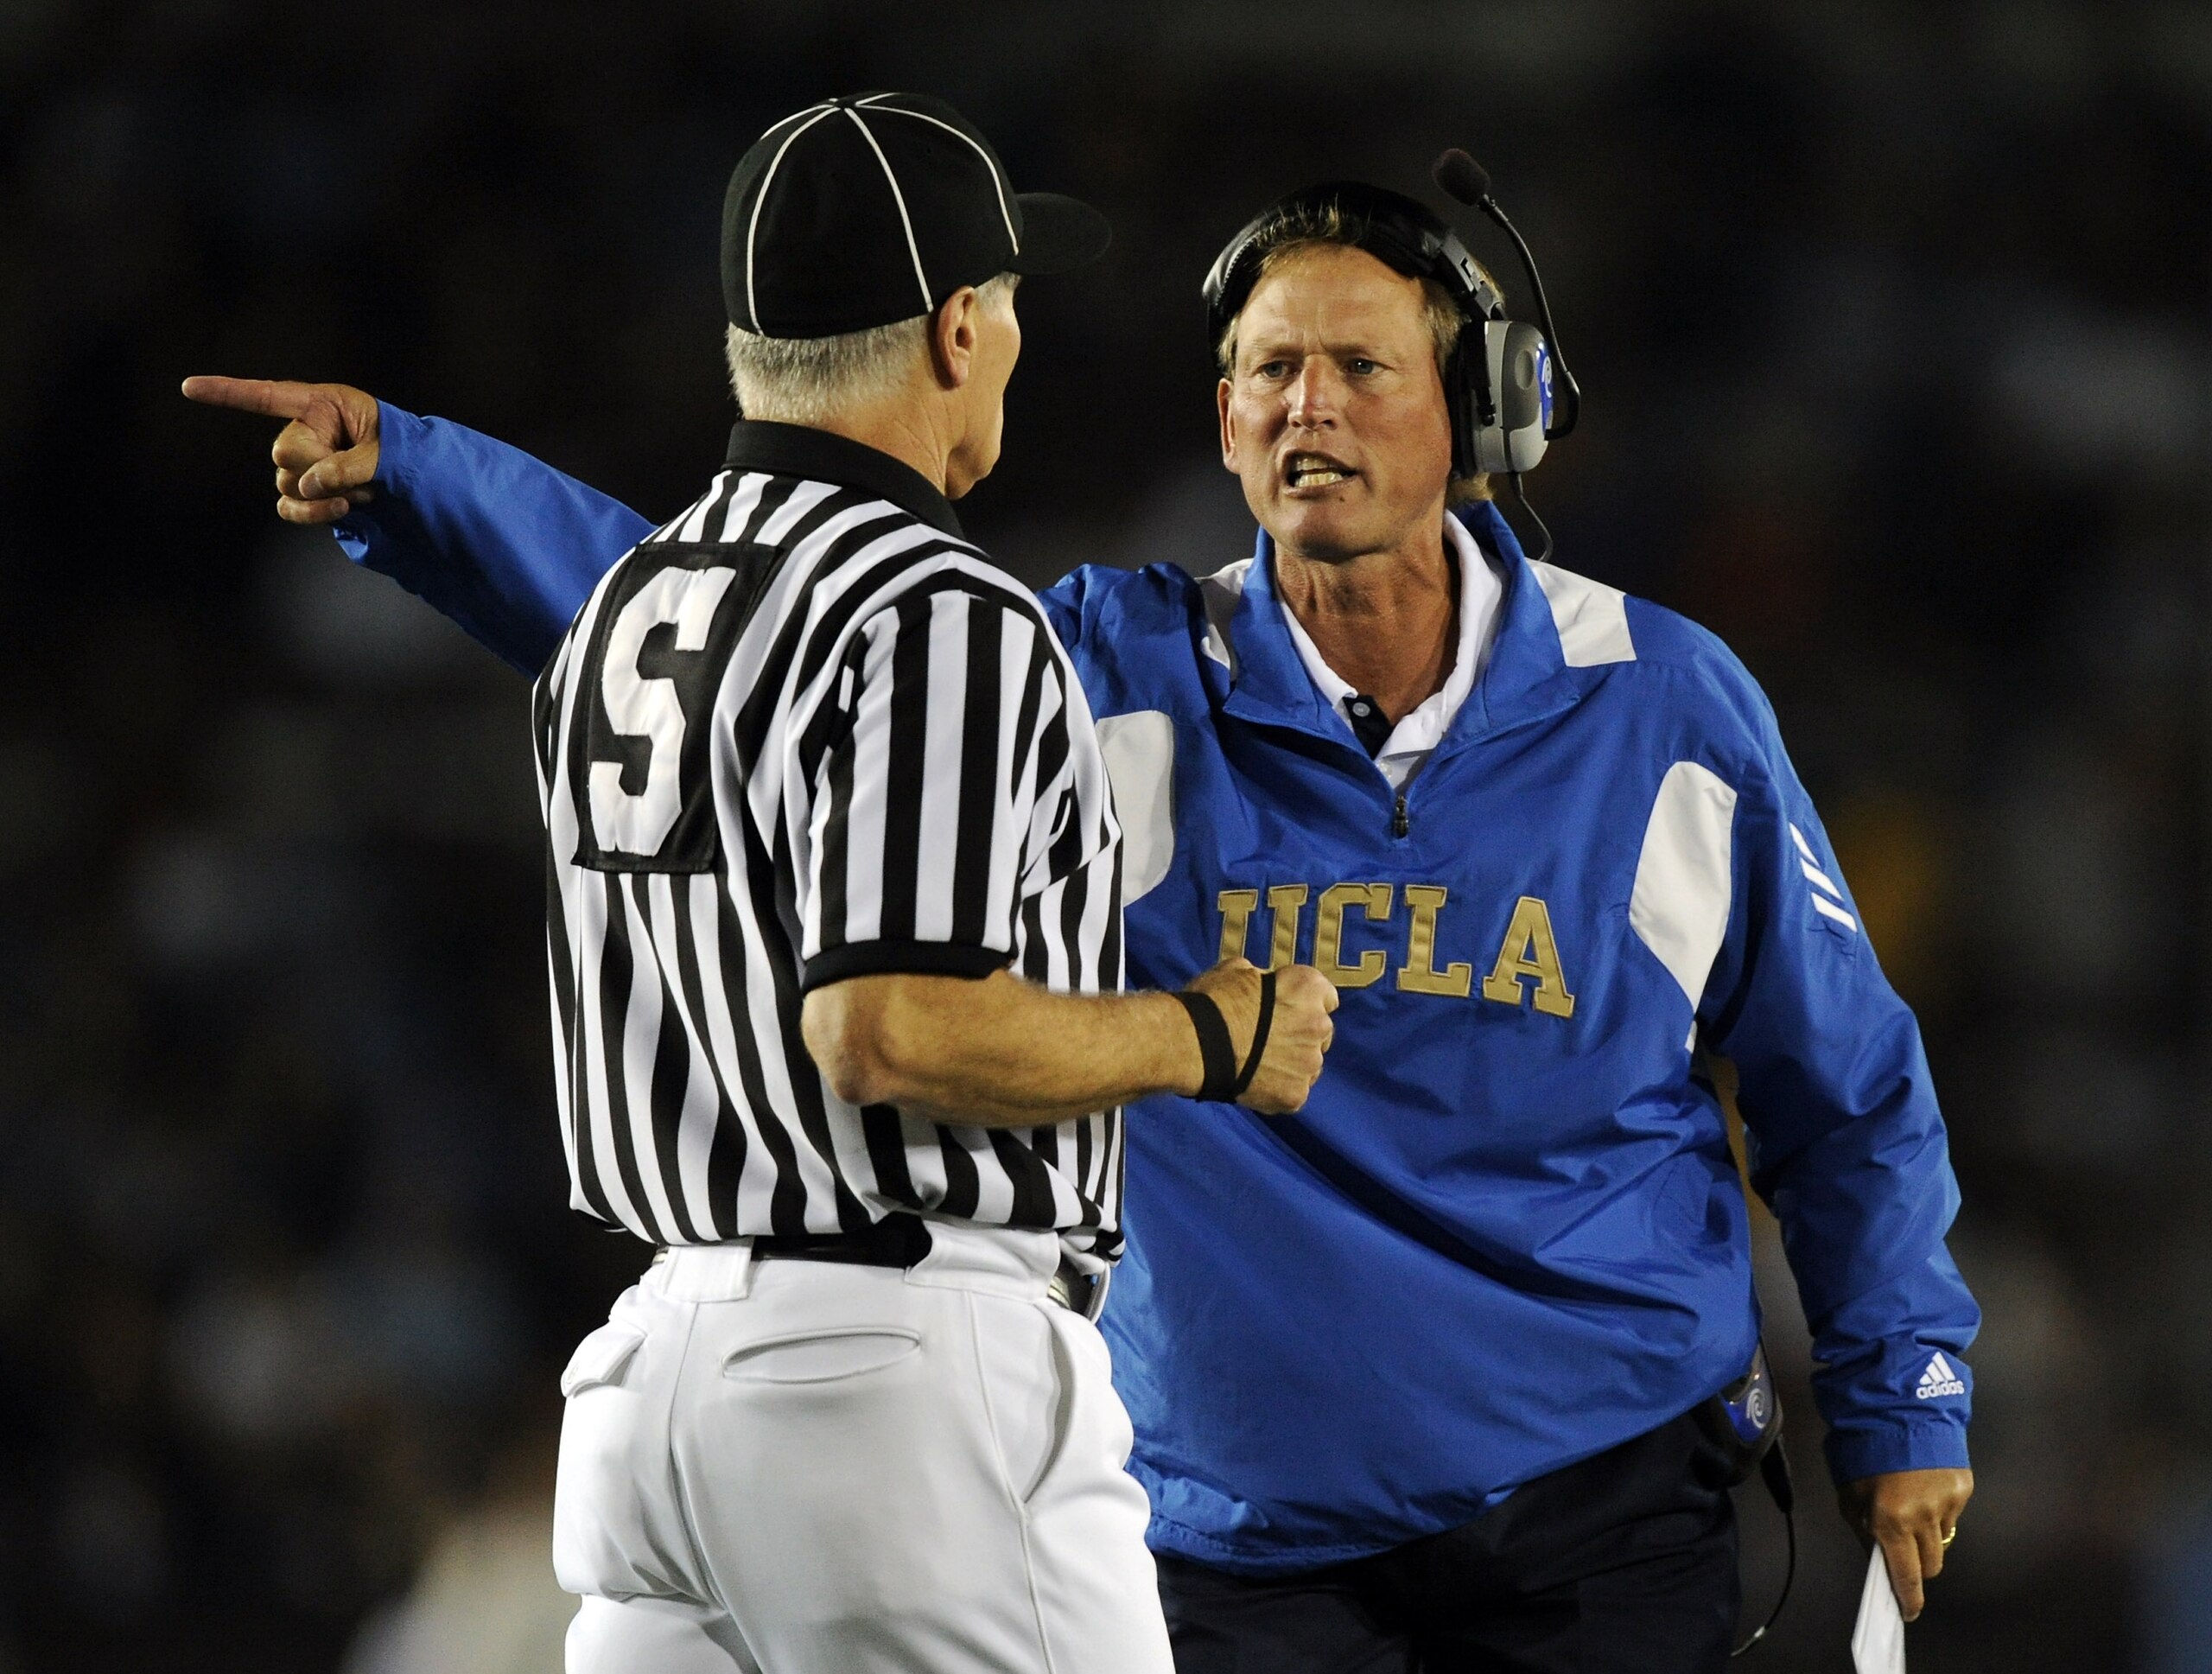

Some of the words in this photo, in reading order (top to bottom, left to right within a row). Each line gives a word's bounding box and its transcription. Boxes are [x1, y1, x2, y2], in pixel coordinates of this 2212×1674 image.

[588, 565, 737, 857] S
[1217, 882, 1575, 1019] UCLA
[1916, 1380, 1965, 1399] adidas
